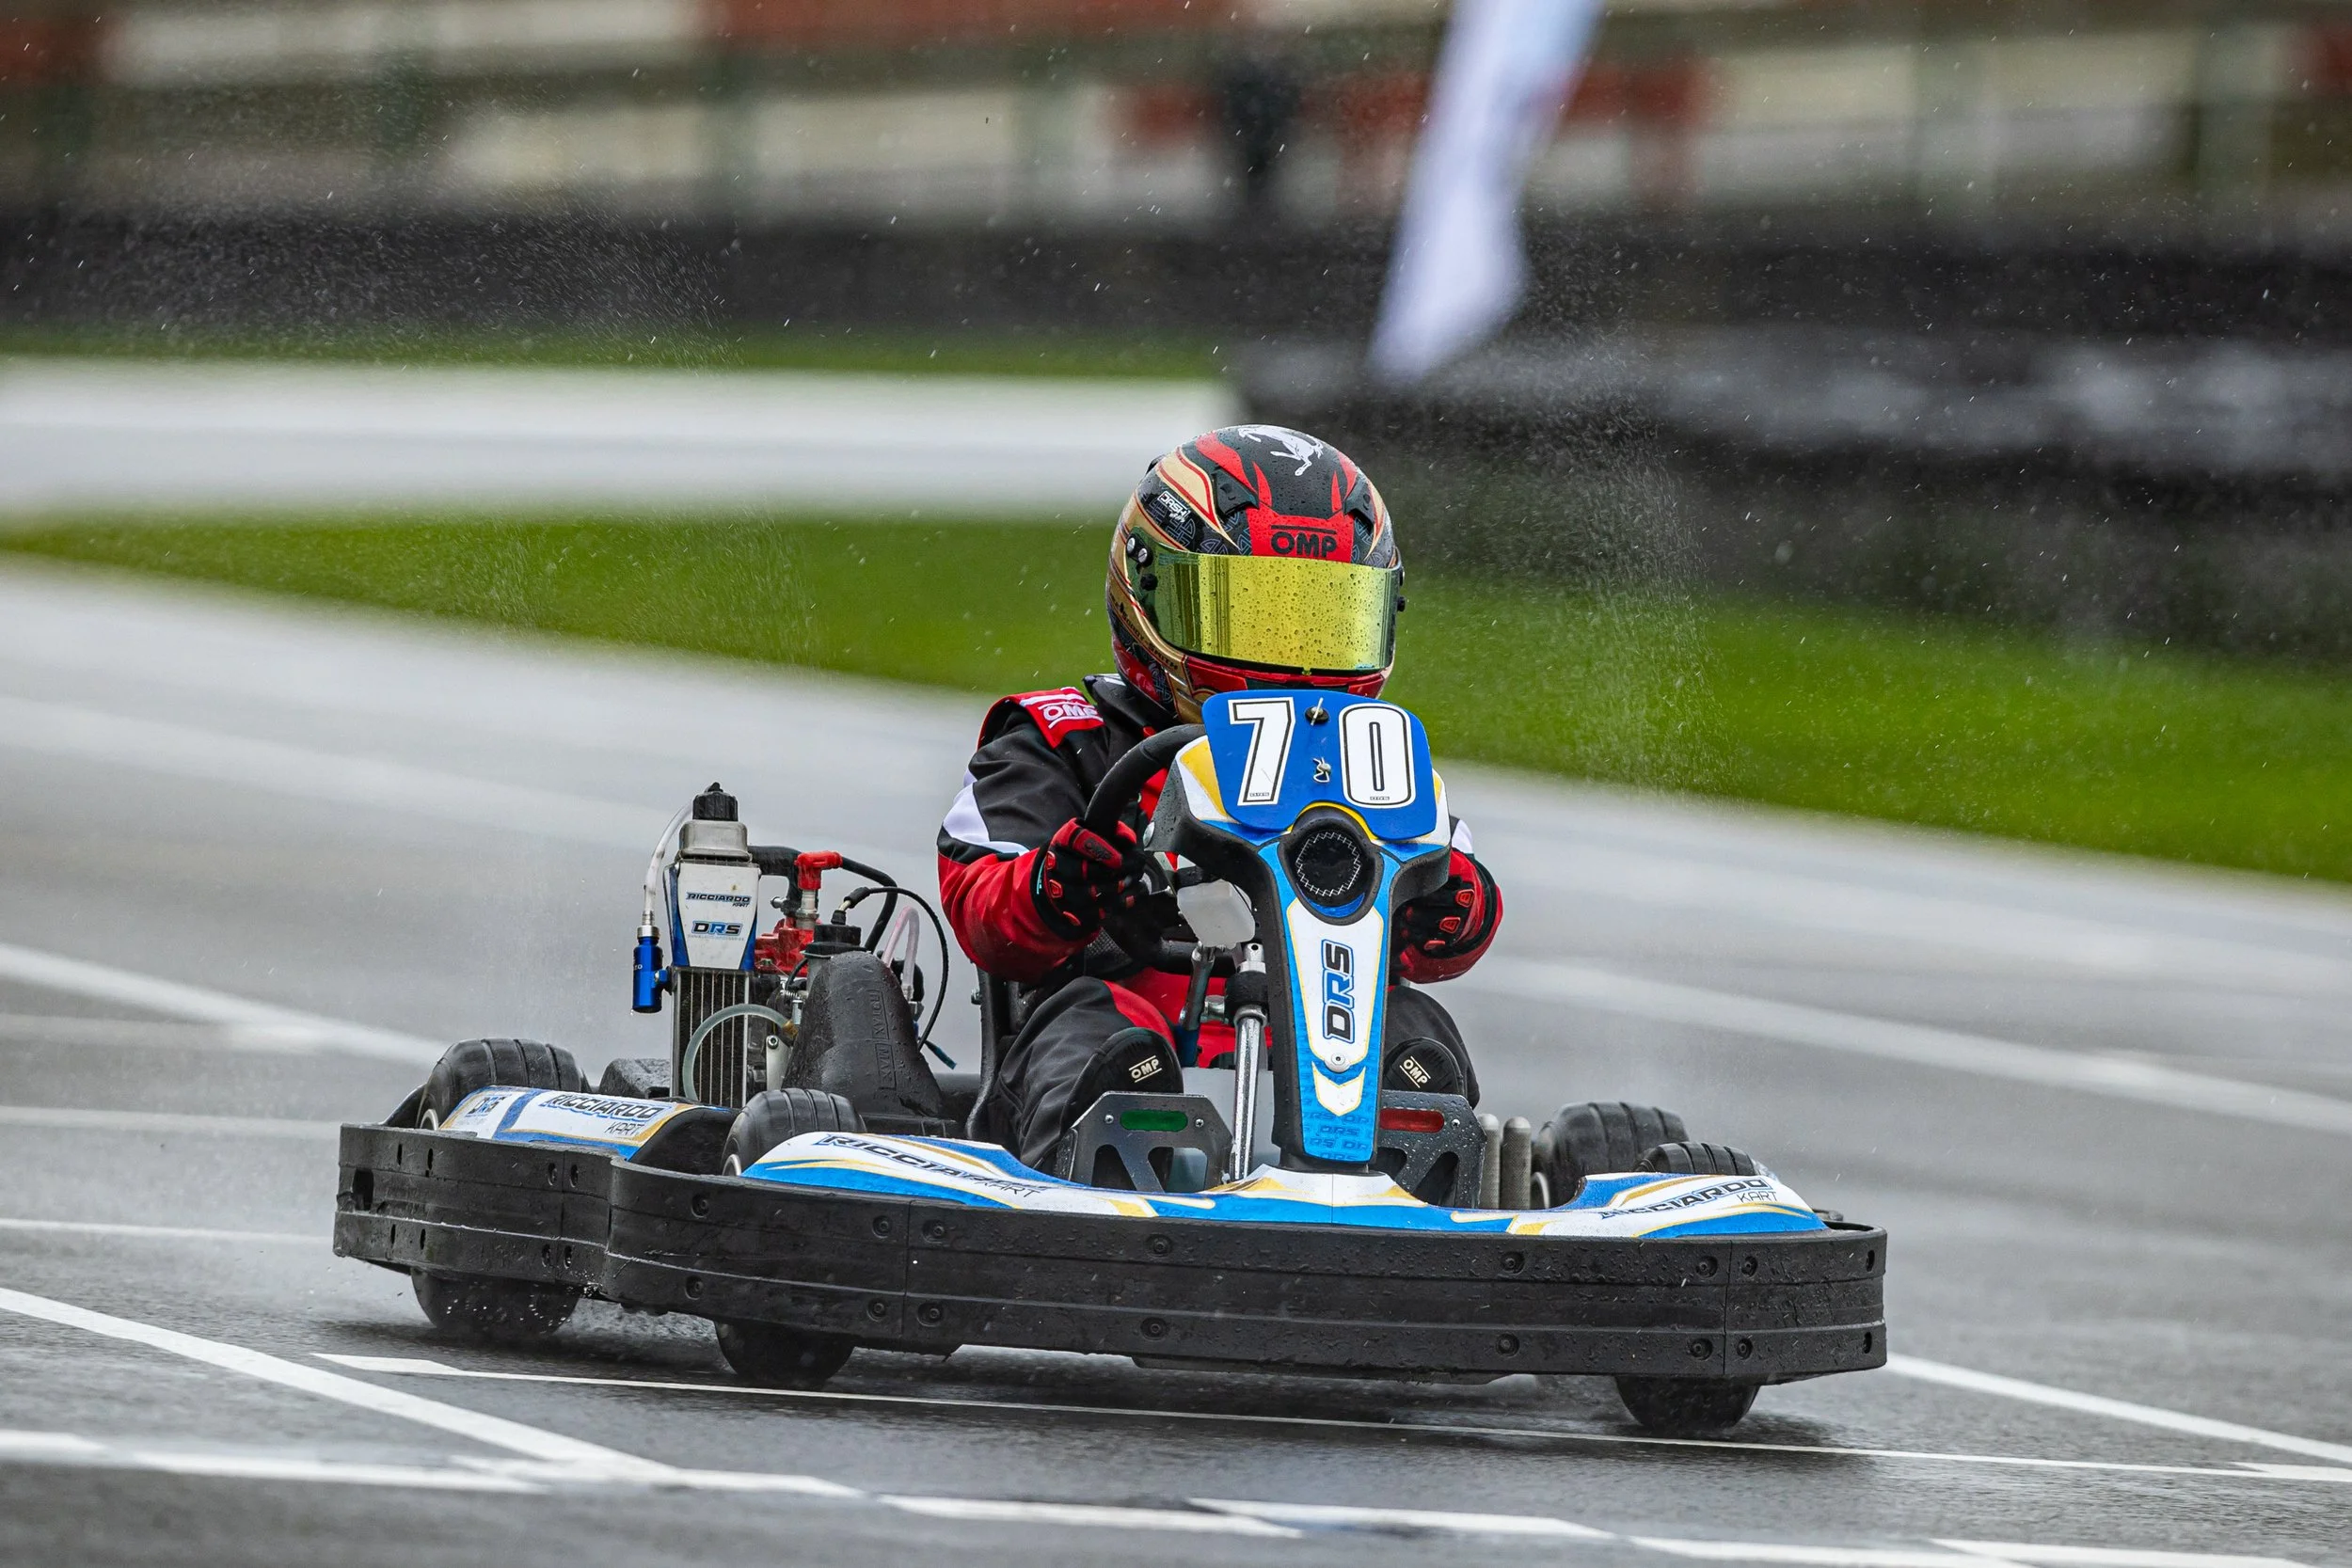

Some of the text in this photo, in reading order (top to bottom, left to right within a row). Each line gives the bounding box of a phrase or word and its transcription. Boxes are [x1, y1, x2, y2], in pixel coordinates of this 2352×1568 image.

[1271, 531, 1337, 558] OMP
[1043, 704, 1098, 721] OMP
[687, 893, 751, 903] RICCIARDO
[692, 922, 742, 935] DRS
[1324, 941, 1353, 1042] DRS
[1132, 1059, 1159, 1079] OMP
[1404, 1059, 1428, 1084] OMP
[546, 1094, 667, 1119] RICCIARDO
[603, 1121, 645, 1135] KART
[1737, 1191, 1777, 1203] KART
